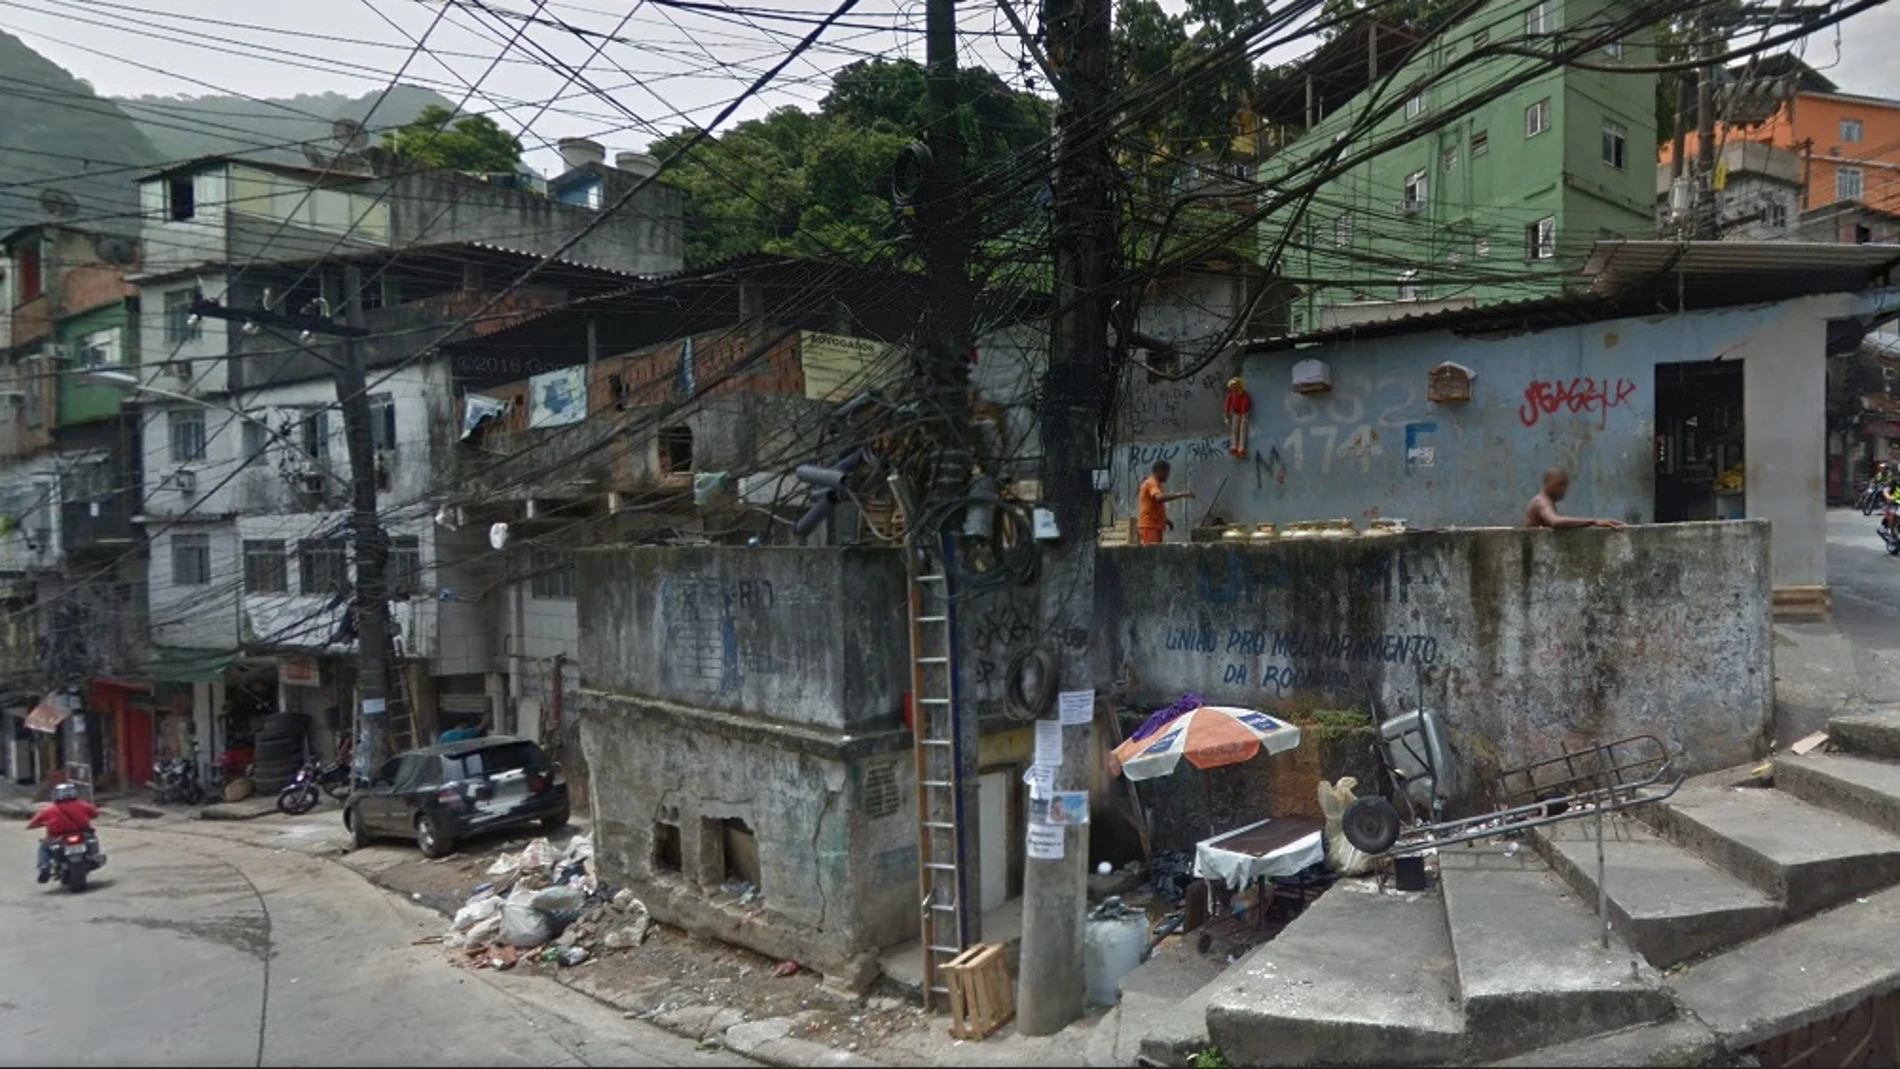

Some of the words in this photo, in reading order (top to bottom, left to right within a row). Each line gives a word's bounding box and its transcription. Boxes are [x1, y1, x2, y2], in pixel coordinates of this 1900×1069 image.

[1283, 424, 1384, 476] 174
[1226, 629, 1266, 656] PRO
[1223, 664, 1247, 685] DA
